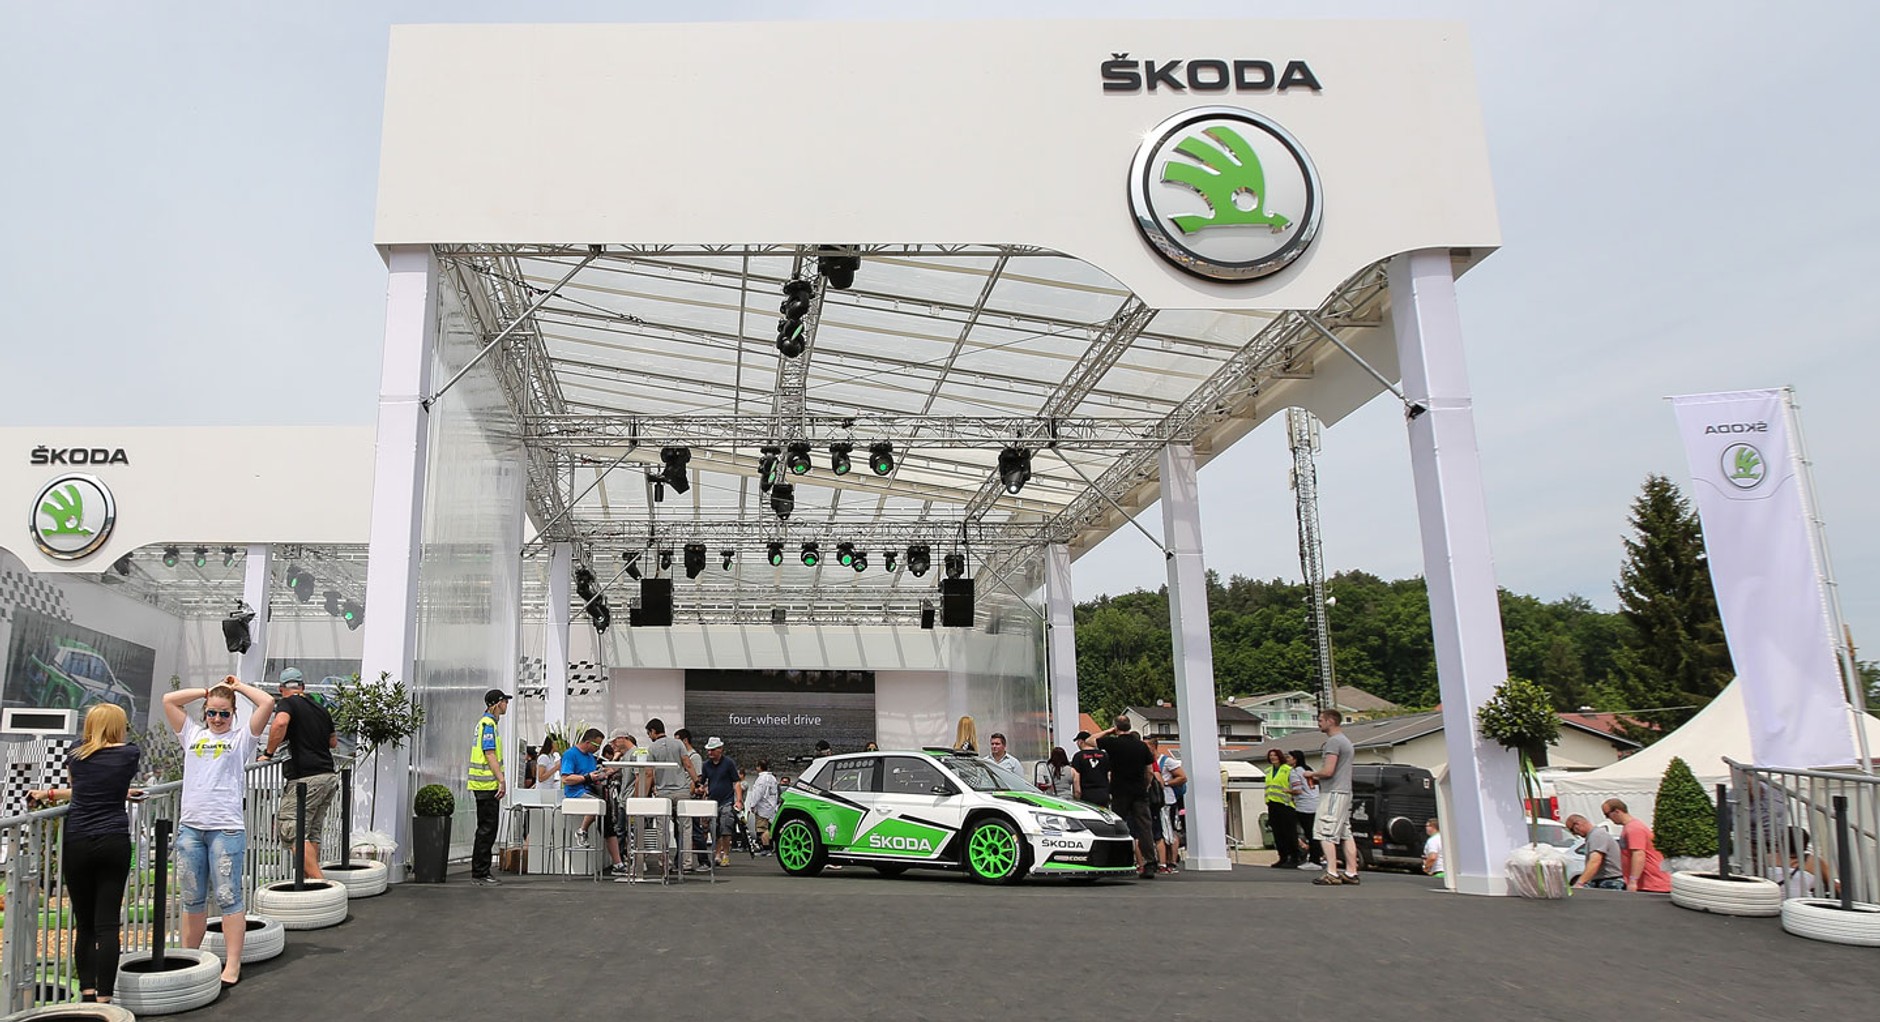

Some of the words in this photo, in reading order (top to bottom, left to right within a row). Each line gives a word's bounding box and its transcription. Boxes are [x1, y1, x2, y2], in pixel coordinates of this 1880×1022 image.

[1101, 53, 1323, 91] ŠKODA
[30, 445, 128, 465] ŠKODA
[729, 713, 790, 725] four-wheel
[794, 713, 821, 725] drive
[869, 832, 932, 851] ŠKODA
[1041, 838, 1085, 849] ŠKODA
